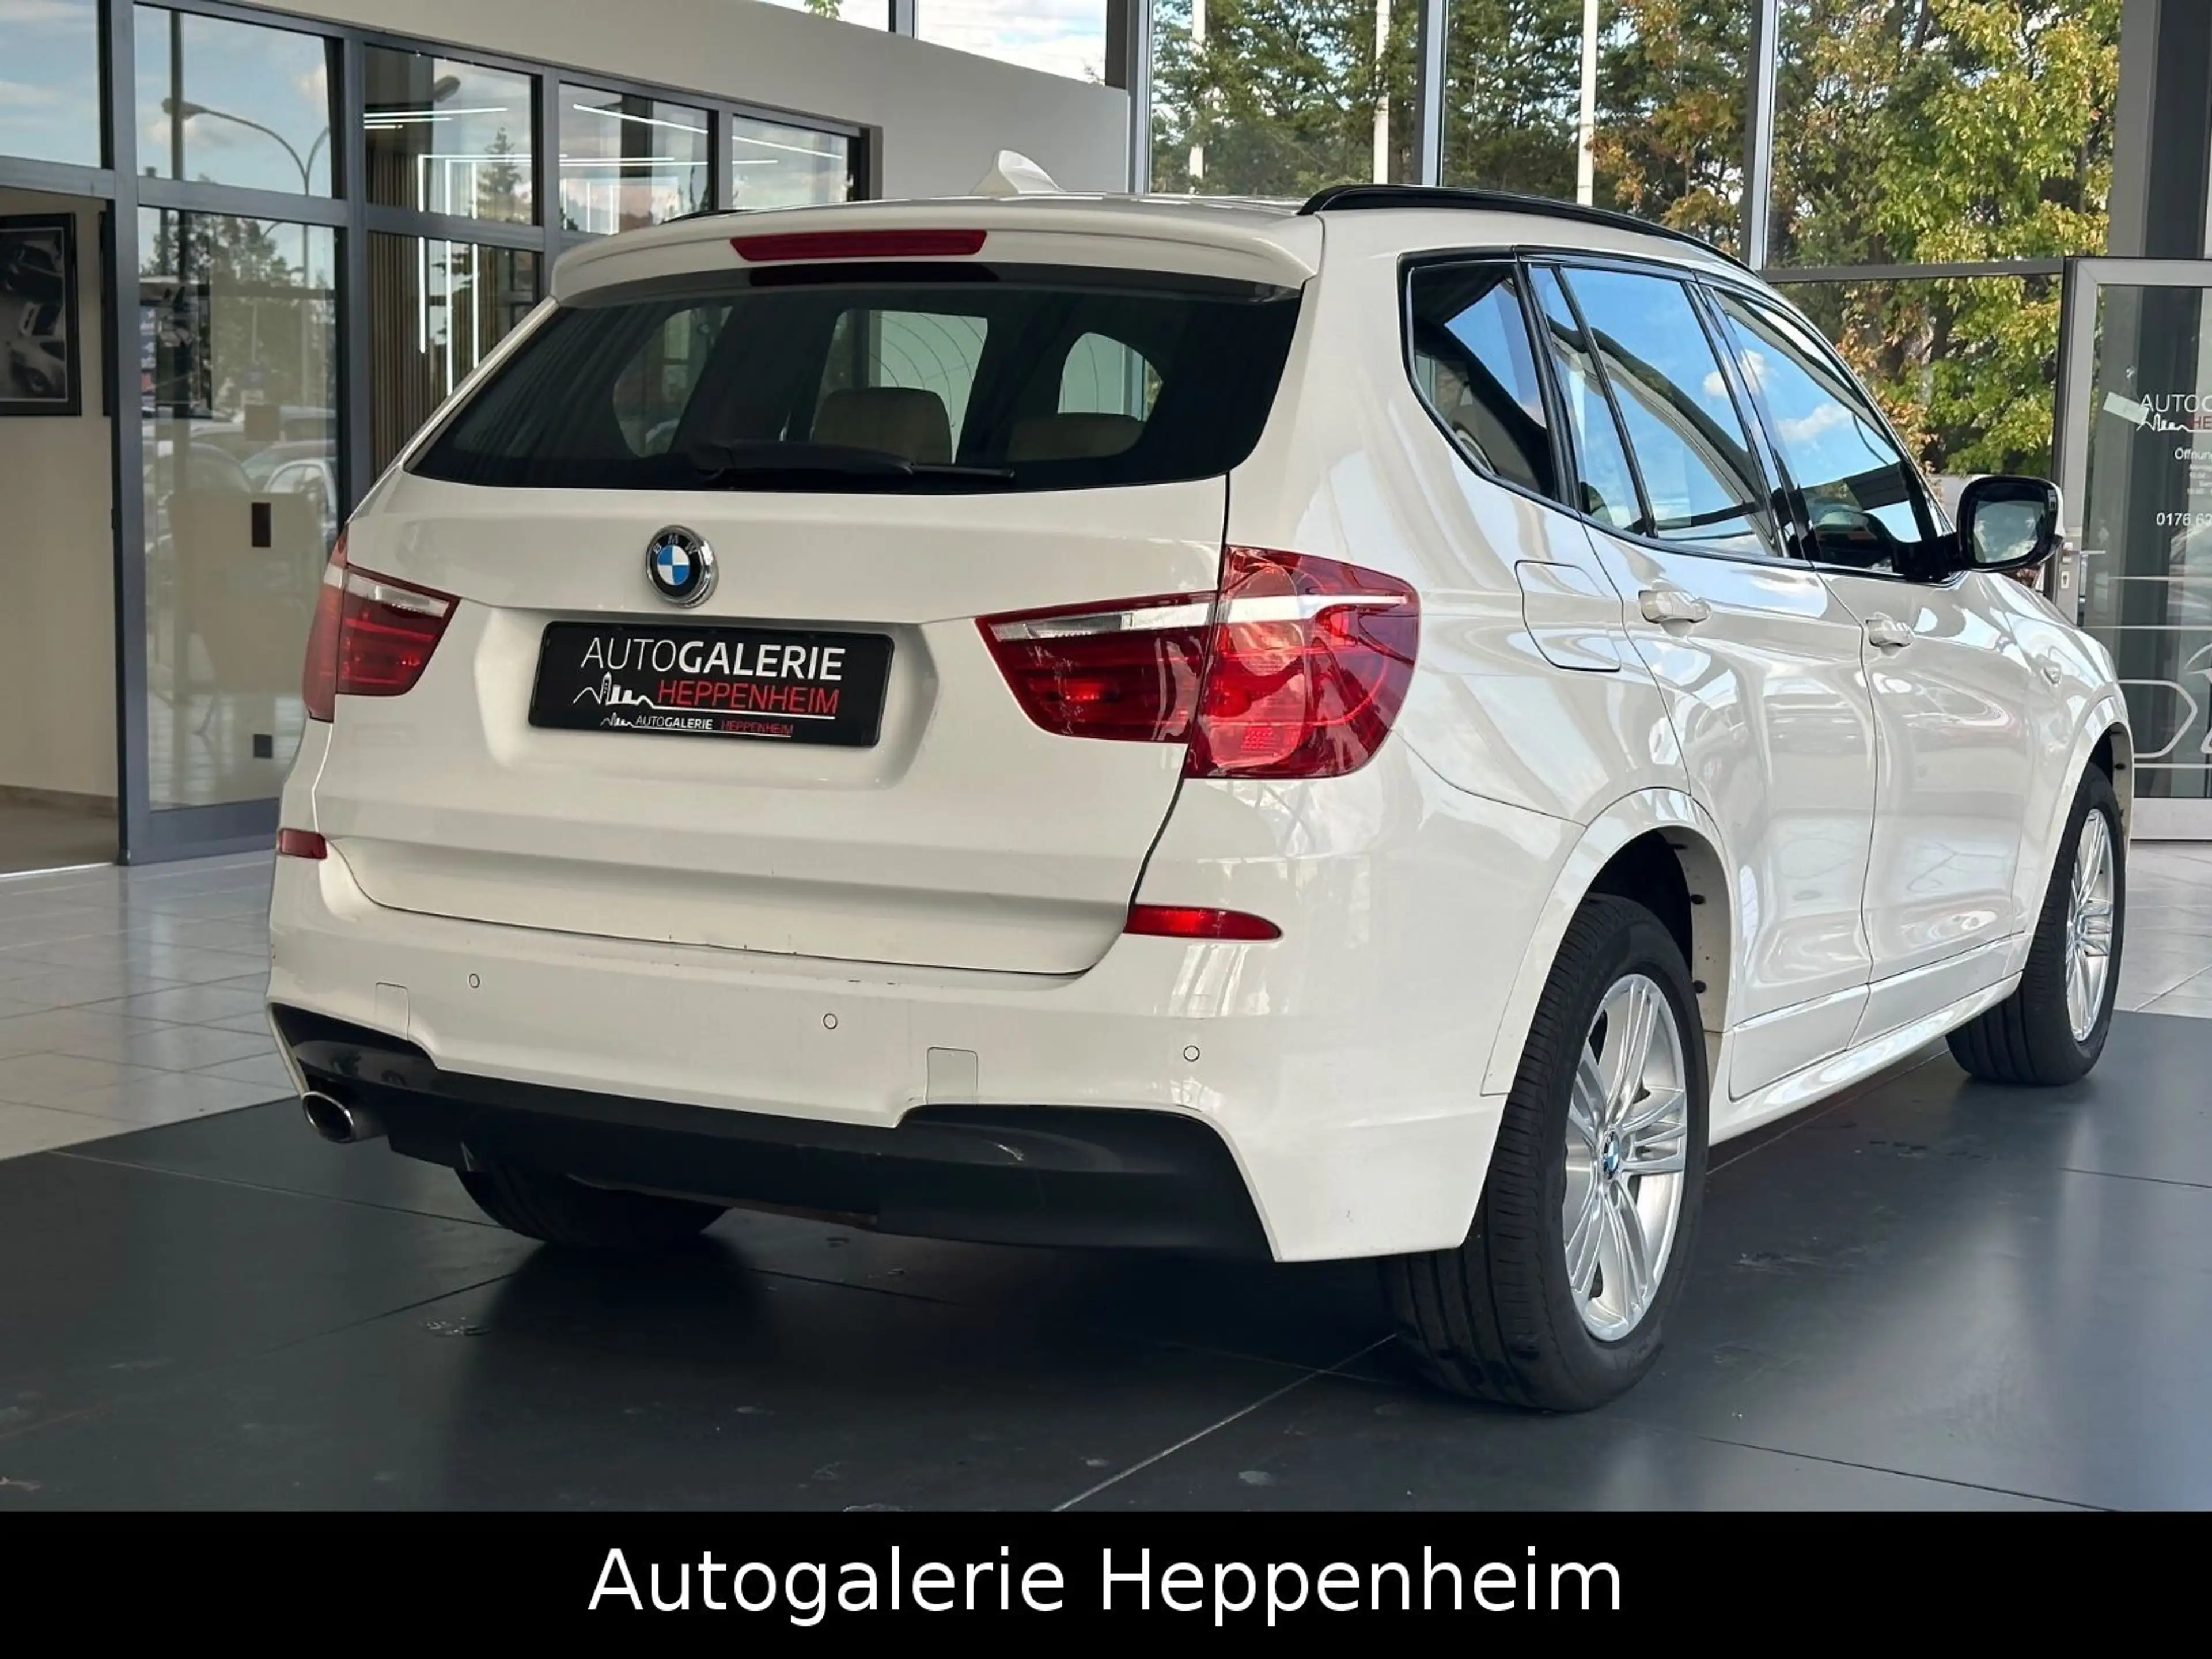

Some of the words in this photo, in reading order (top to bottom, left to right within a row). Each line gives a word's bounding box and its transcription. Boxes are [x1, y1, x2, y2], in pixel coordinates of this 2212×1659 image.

[2174, 446, 2212, 461] Öffnun
[2156, 512, 2191, 527] 0176
[652, 534, 698, 554] BMW
[580, 637, 846, 681] AUTOGALERIE
[657, 679, 840, 714] HEPPENHEIM
[635, 715, 714, 730] AUTOGALERIE
[721, 720, 794, 735] HEPPENHEIM
